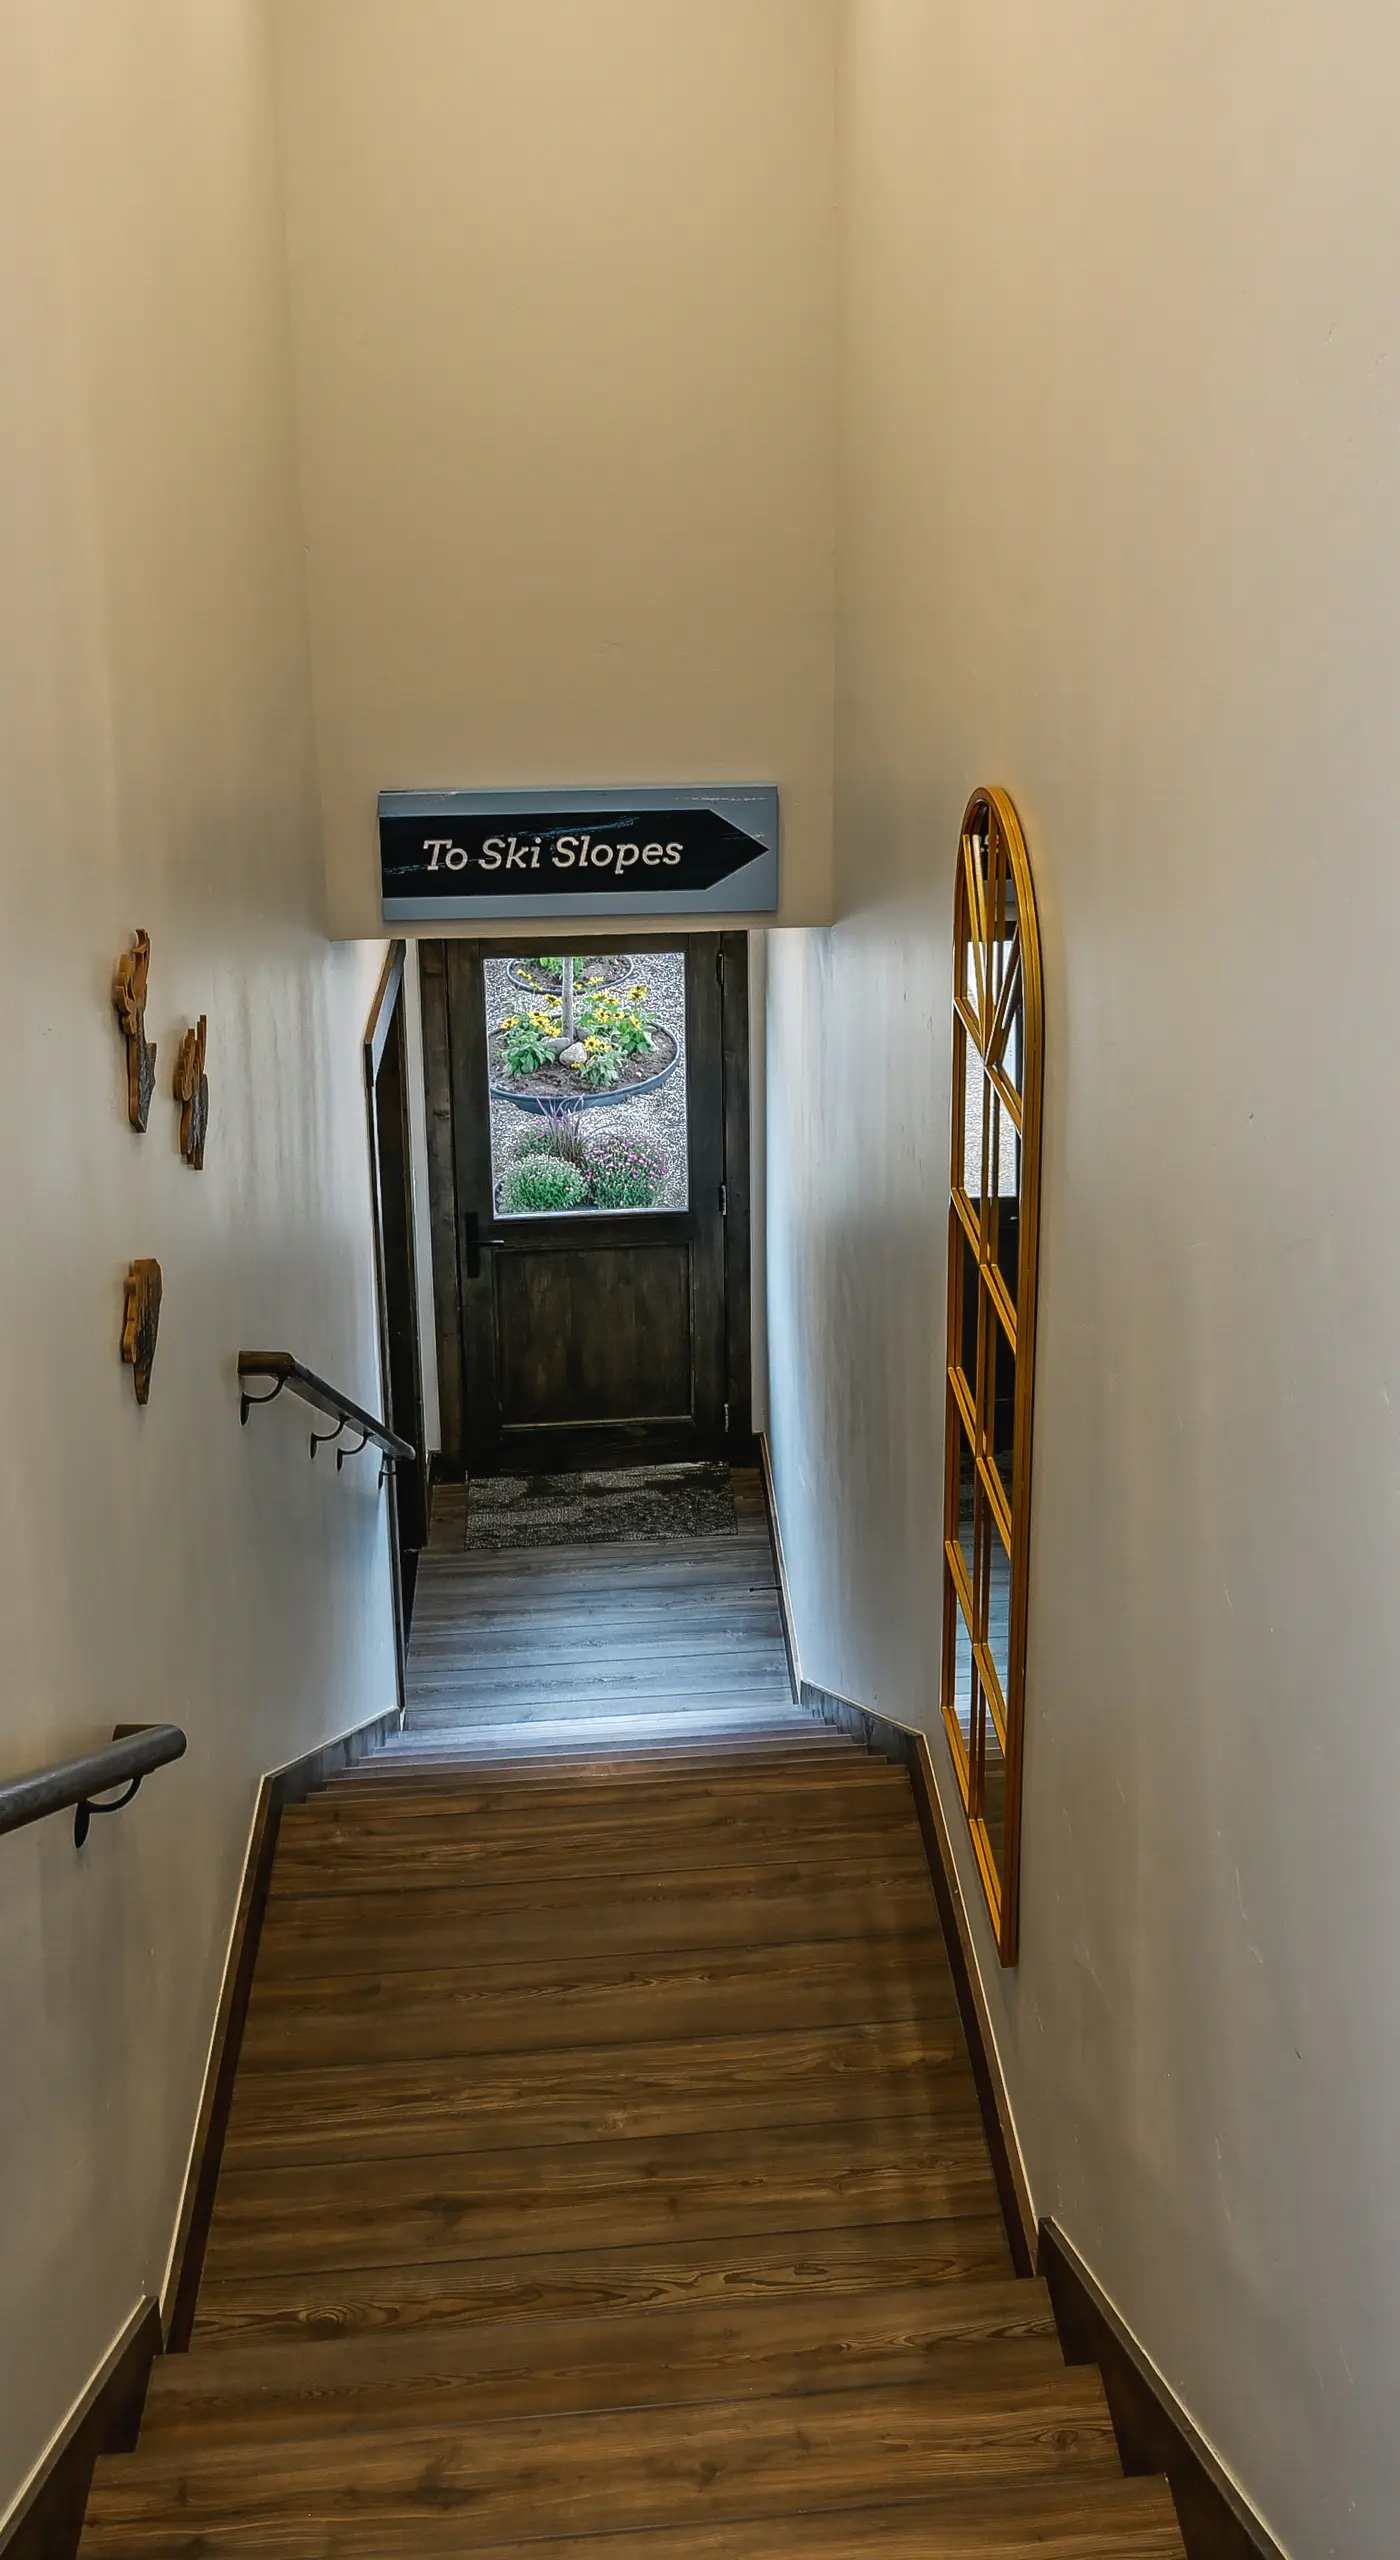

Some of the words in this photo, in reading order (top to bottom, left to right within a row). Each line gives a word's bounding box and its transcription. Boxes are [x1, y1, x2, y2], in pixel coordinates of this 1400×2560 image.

[423, 839, 468, 871] To
[478, 836, 541, 870] Ski
[552, 835, 684, 875] Slopes
